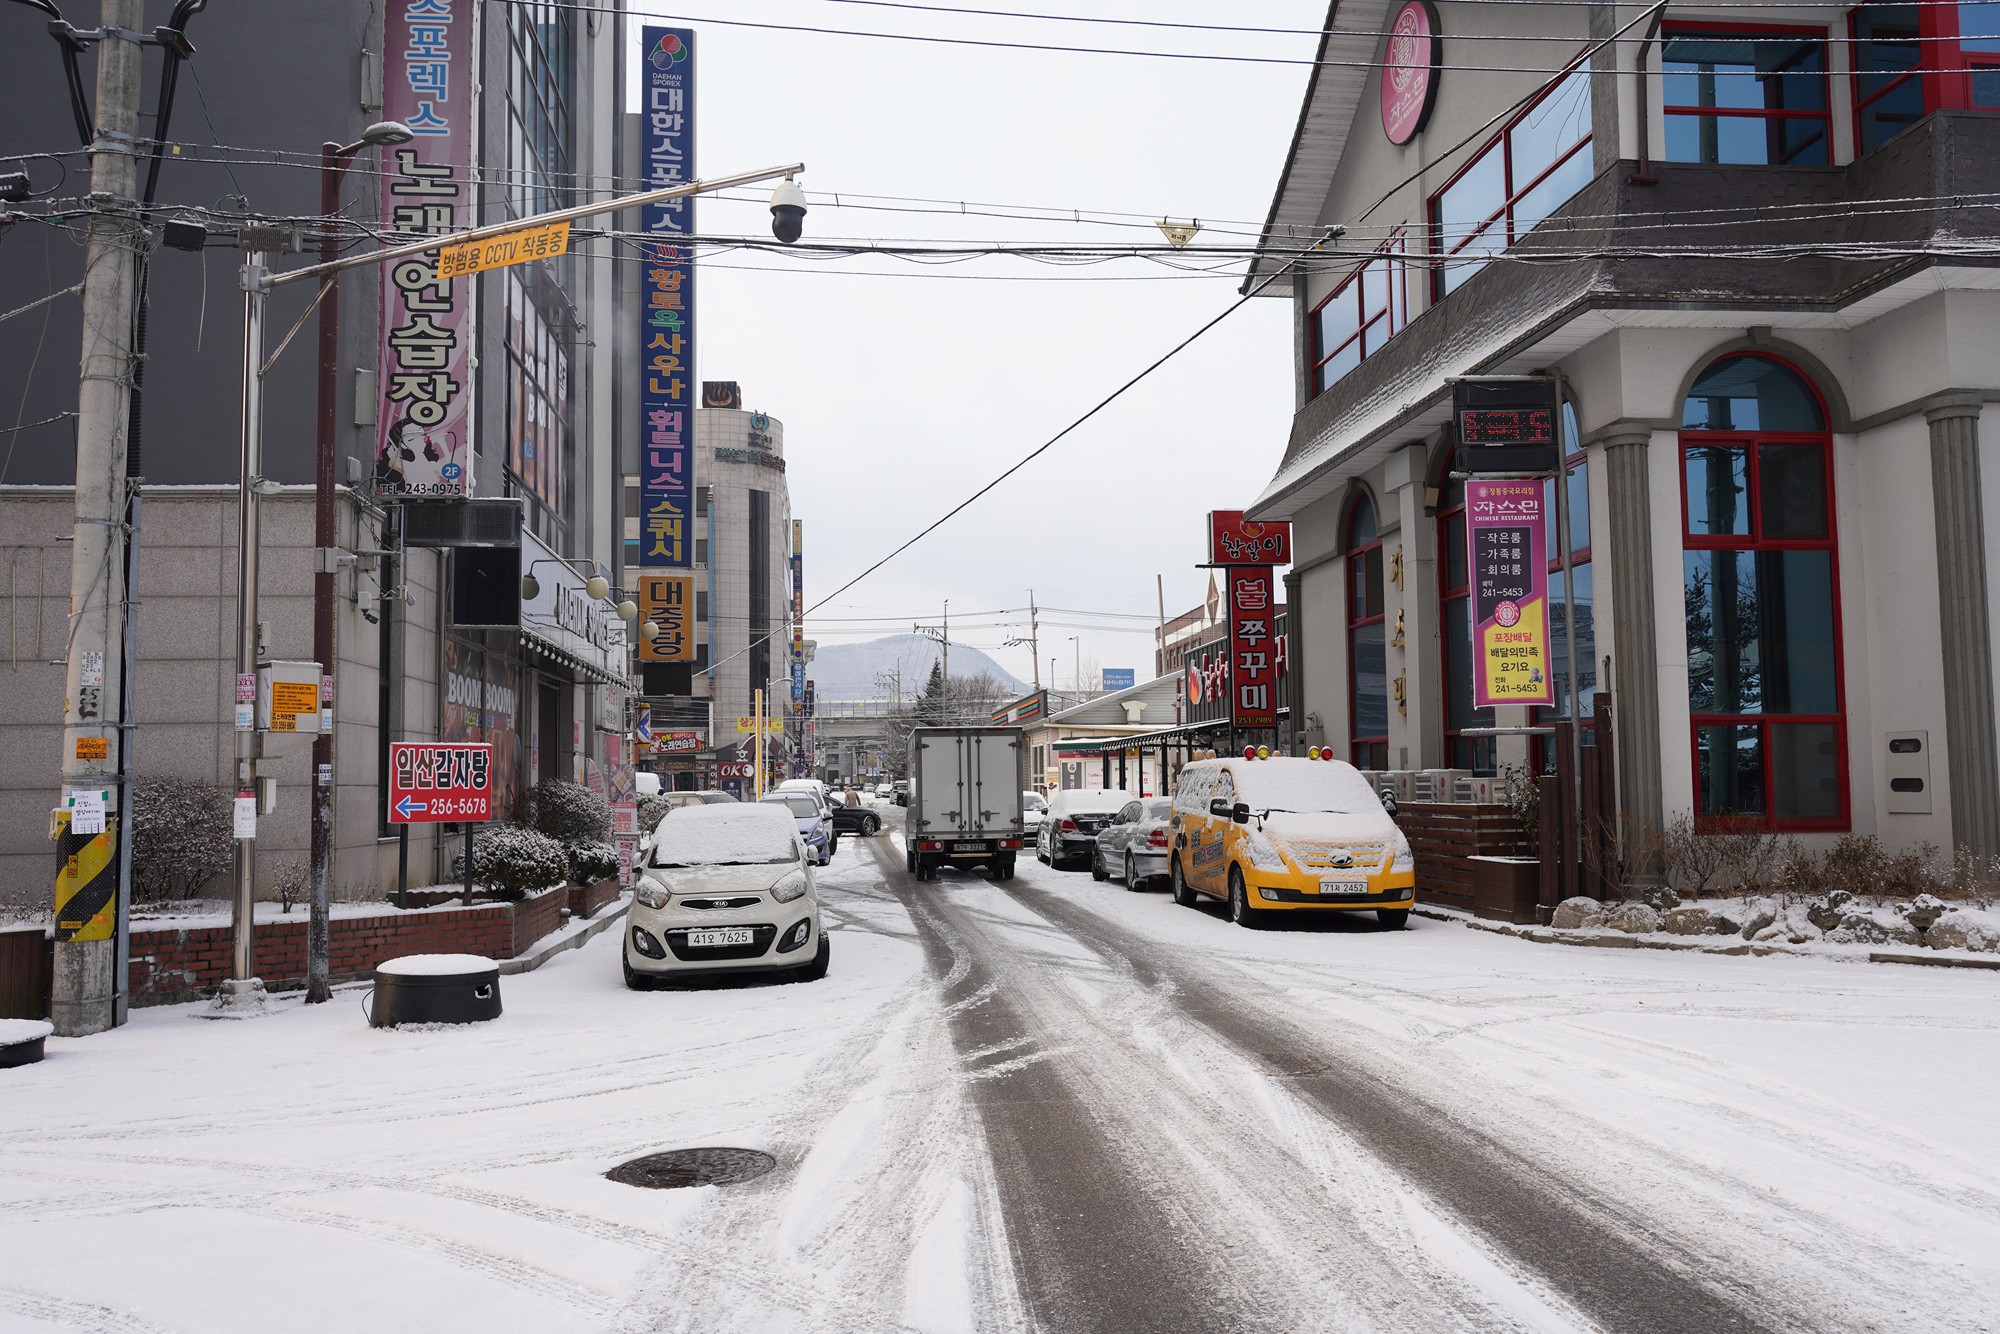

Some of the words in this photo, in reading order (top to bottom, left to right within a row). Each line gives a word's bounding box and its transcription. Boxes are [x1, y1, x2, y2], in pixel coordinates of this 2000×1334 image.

[652, 73, 682, 81] DAEHAN
[652, 79, 681, 87] SPOREX
[442, 247, 481, 275] 방범용
[485, 240, 518, 265] CCTV
[522, 231, 563, 257] 작동중
[648, 410, 685, 490] 휘트니스
[445, 466, 458, 477] 2F
[405, 483, 461, 495] 243-0975
[1489, 487, 1534, 496] 정통중국요리점
[647, 501, 684, 561] 스쿼시
[1221, 531, 1282, 561] 참살이
[1482, 580, 1493, 588] 예약
[1482, 588, 1523, 597] 241-5453
[650, 581, 685, 656] 대중탕
[1494, 632, 1532, 643] 포장배달
[1491, 647, 1539, 657] 배달의민족
[1501, 662, 1529, 672] 요기요
[448, 671, 482, 710] BOOM
[1496, 684, 1538, 693] 241-5453
[661, 733, 672, 742] OK
[661, 738, 696, 751] 노래연습장
[396, 748, 490, 790] 일산감자탕
[721, 765, 741, 776] OK
[430, 798, 487, 815] 256-5678
[1343, 883, 1364, 892] 2452
[693, 934, 715, 944] 41오
[720, 931, 748, 943] 7625
